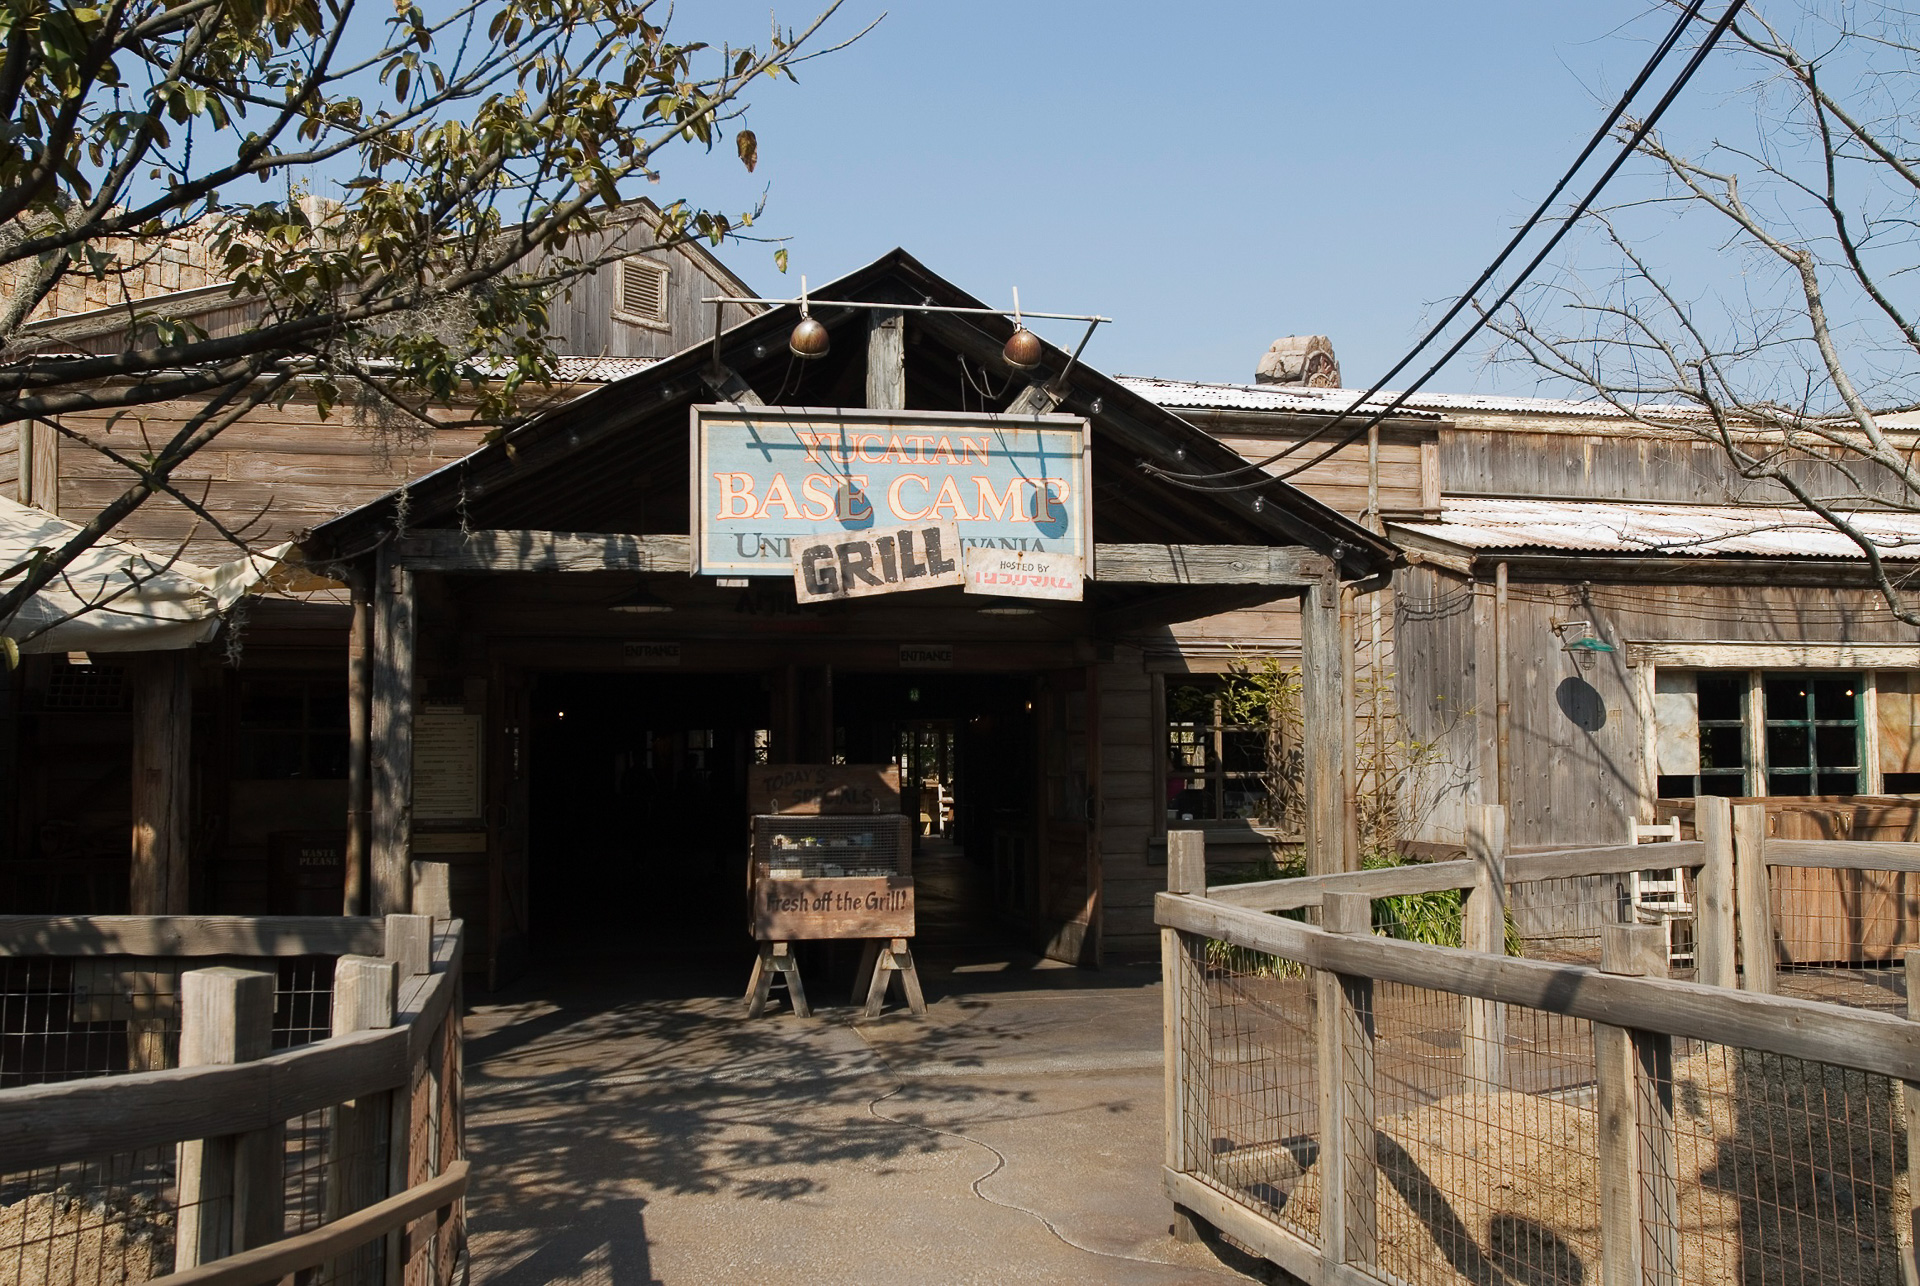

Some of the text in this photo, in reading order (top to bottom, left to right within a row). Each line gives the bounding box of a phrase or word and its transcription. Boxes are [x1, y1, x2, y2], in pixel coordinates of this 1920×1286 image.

[797, 432, 991, 467] YUCATAN
[713, 472, 1071, 523] BASE CAMP
[733, 532, 793, 558] UNI
[801, 527, 956, 596] GRILL
[1000, 561, 1050, 573] HOSTED BY
[624, 645, 680, 657] ENTRANCE
[900, 650, 953, 662] ENTRANCE
[764, 769, 827, 794] TODAY'S
[792, 787, 874, 806] SPECIALS
[299, 857, 340, 866] PLEASE
[300, 848, 337, 857] WASTE
[766, 889, 907, 912] Fresh off the Grill!
